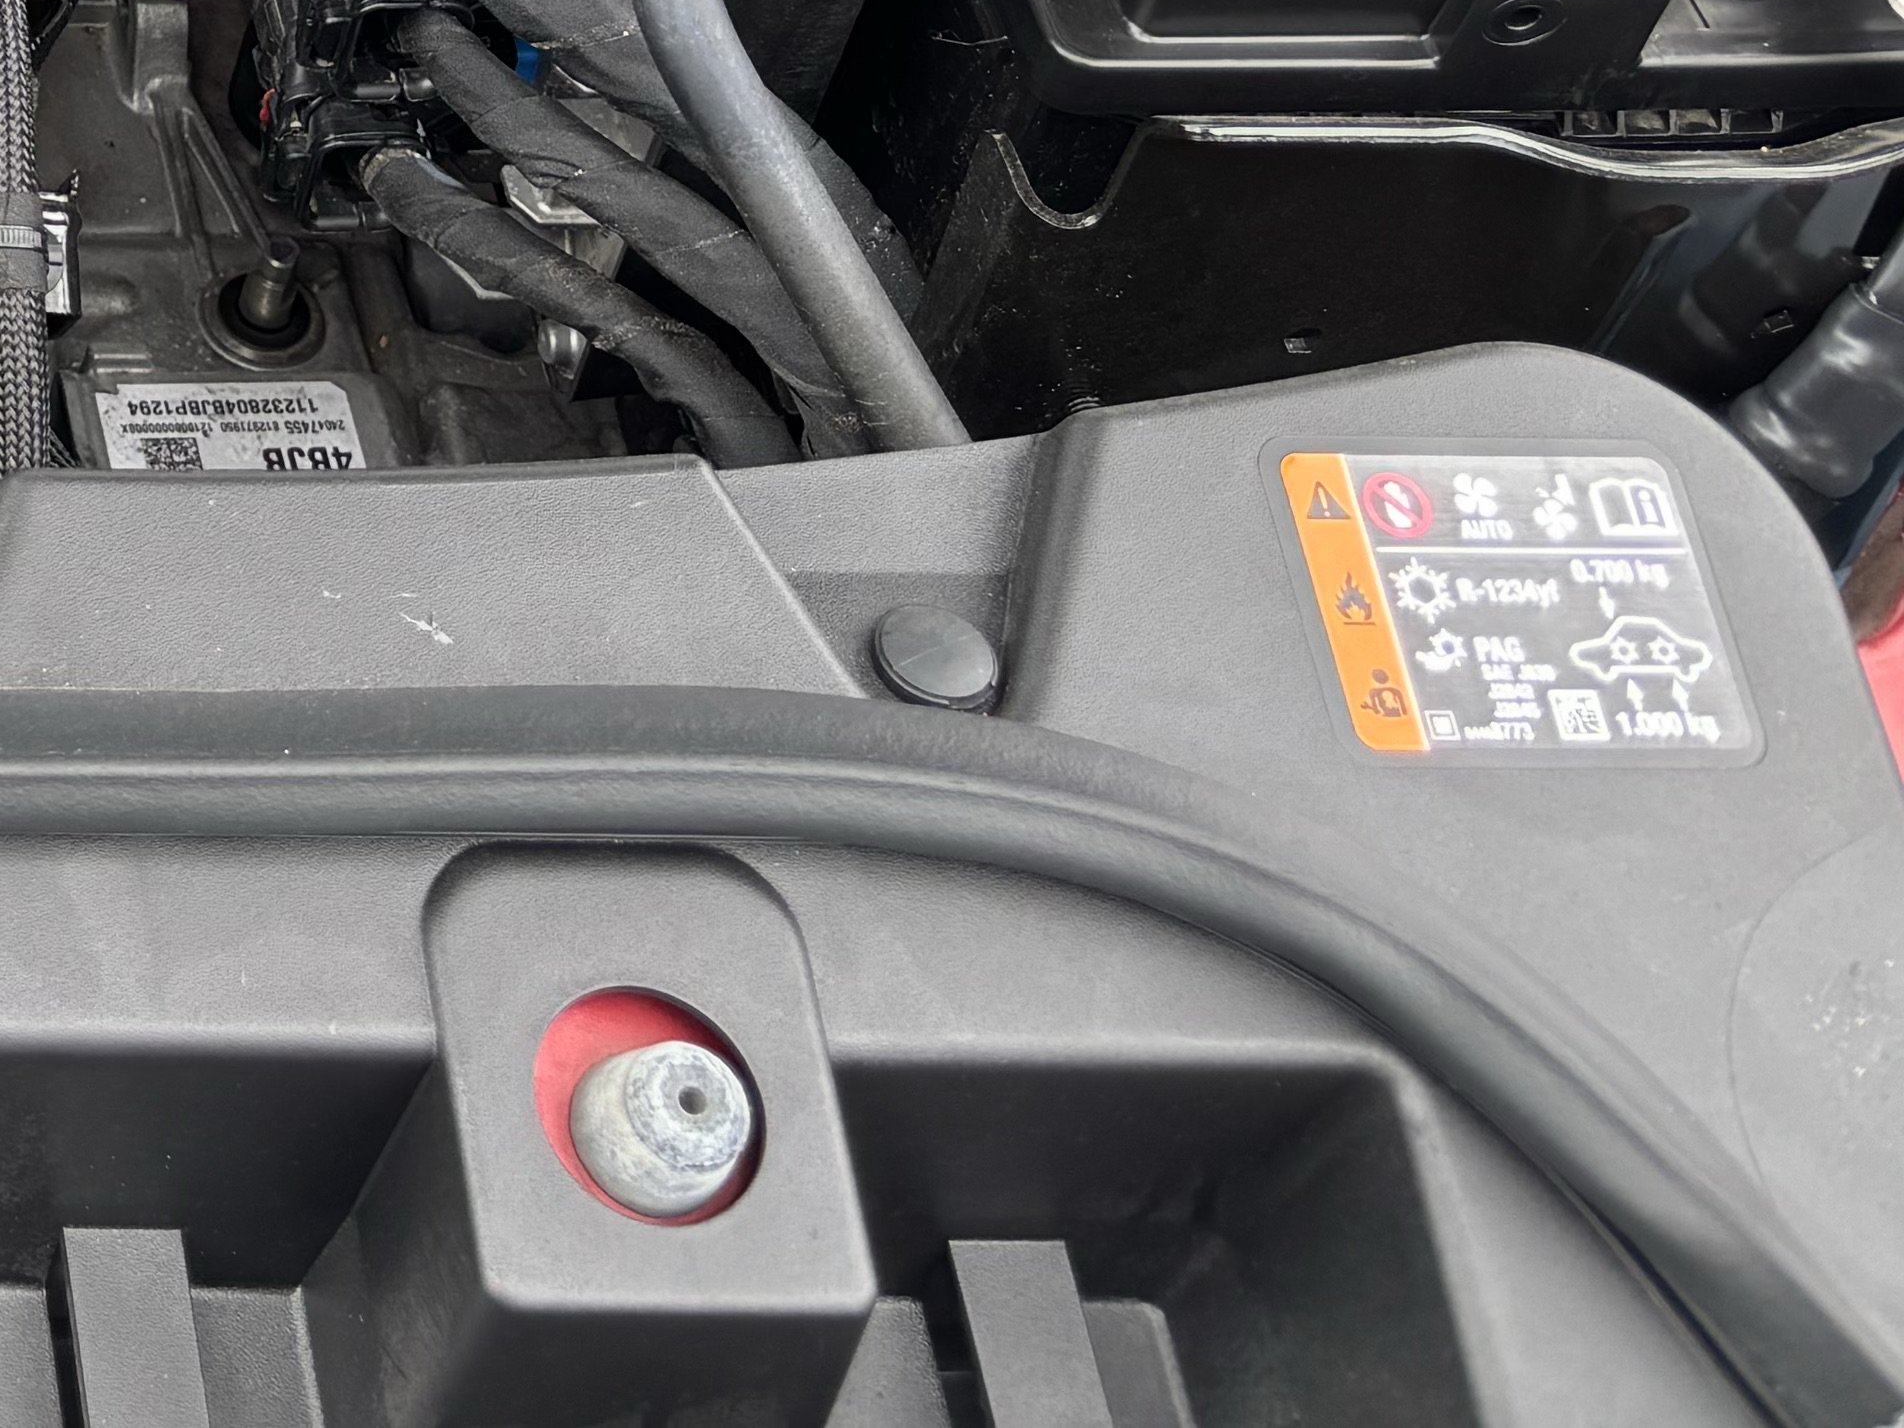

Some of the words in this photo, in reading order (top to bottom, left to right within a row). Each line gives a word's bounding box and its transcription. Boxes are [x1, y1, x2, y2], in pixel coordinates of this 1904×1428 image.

[128, 398, 320, 417] 11232804BJBP1294
[263, 446, 353, 471] 4BJB
[1461, 520, 1513, 540] AUTO
[1570, 559, 1634, 584] 0.700
[1635, 559, 1670, 590] kg
[1473, 636, 1526, 663] PAG
[1616, 712, 1684, 737] 1.000
[1685, 714, 1721, 743] kg
